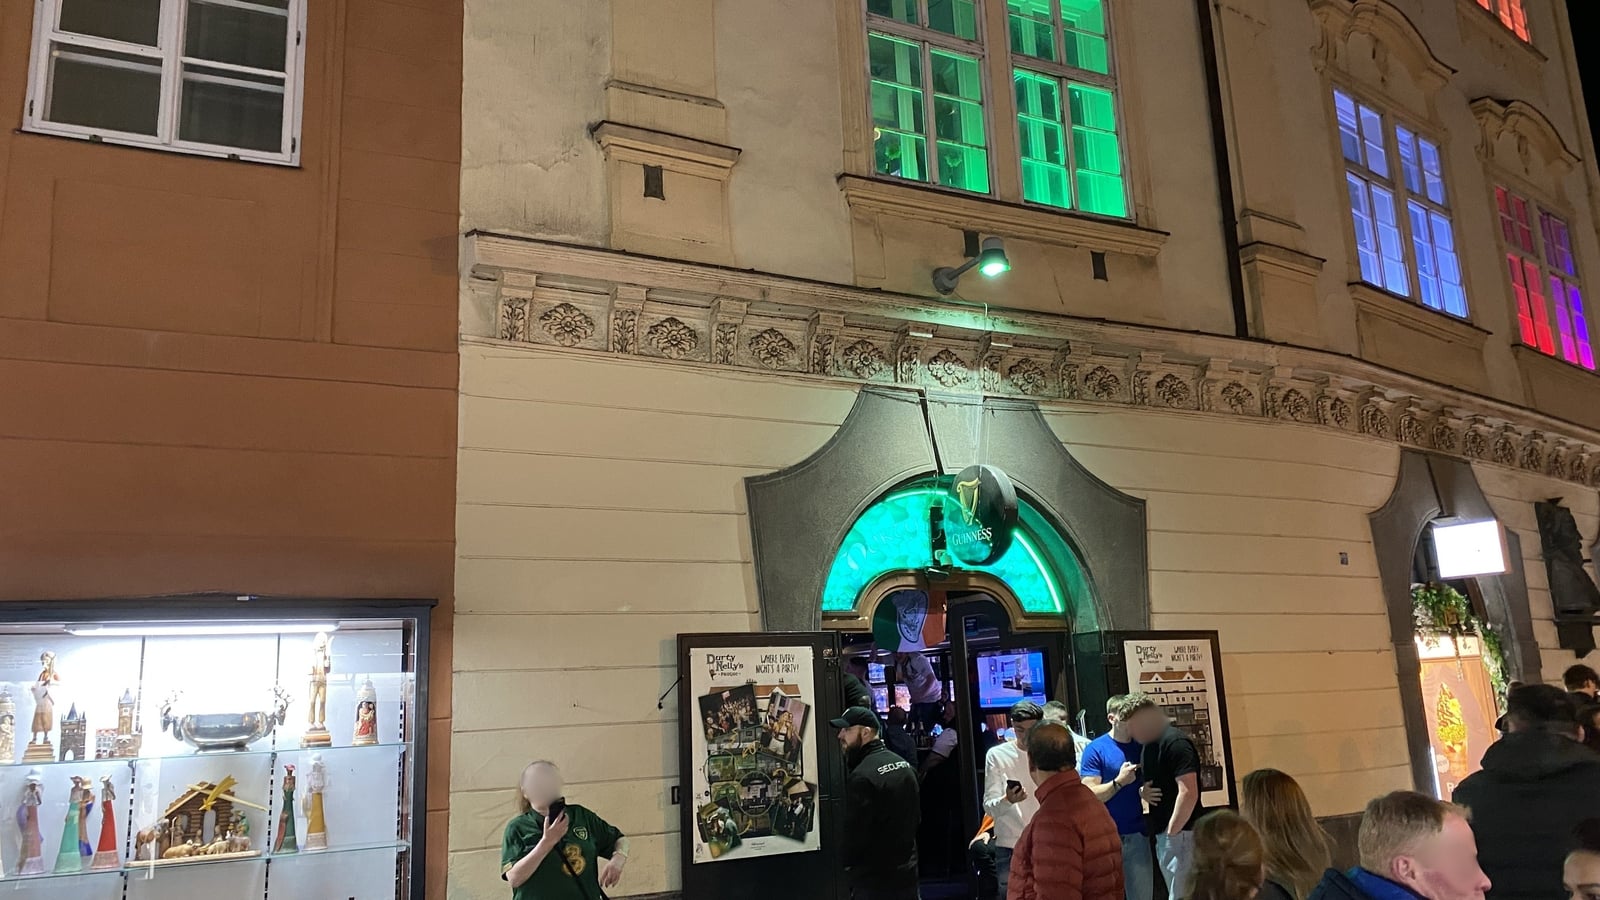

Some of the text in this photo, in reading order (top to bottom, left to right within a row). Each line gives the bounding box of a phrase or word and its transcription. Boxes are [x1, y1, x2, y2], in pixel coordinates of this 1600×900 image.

[952, 527, 992, 545] GUINNESS
[706, 653, 735, 664] Durty
[760, 653, 795, 664] WHERE EVERY
[716, 660, 743, 671] Nelly's
[756, 664, 774, 674] NIGHT'S
